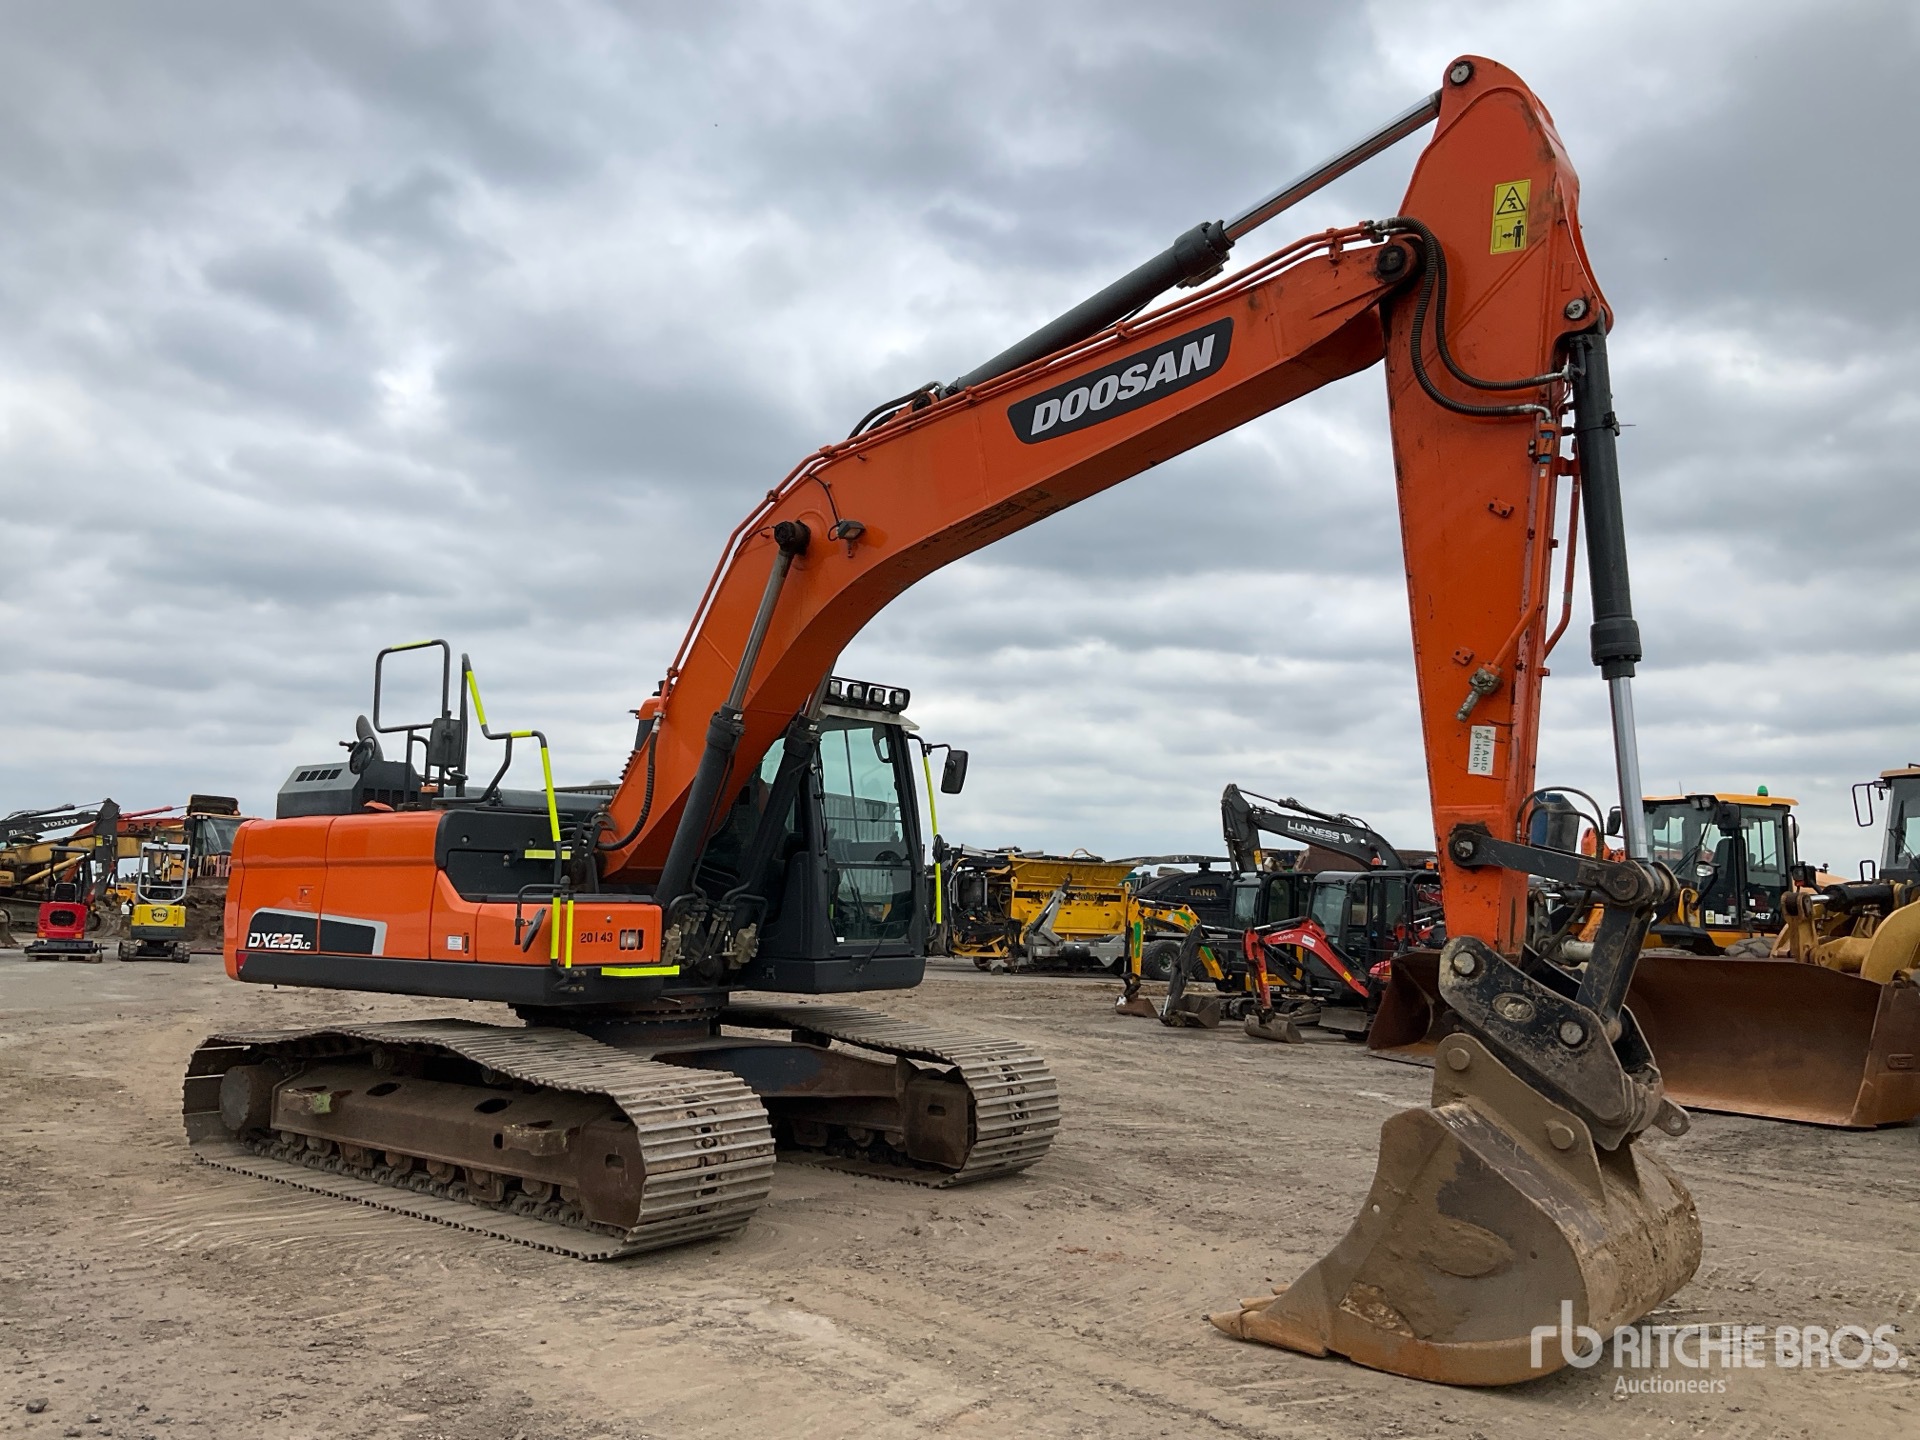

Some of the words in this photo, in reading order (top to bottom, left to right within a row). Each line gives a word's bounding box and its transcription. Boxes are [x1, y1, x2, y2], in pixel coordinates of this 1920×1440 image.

[1030, 333, 1216, 436] DOOSAN
[1480, 750, 1489, 771] Auto
[42, 818, 78, 829] VOLVO
[1287, 820, 1340, 840] LUNNESS
[1189, 888, 1217, 897] TANA
[580, 932, 613, 943] 20143
